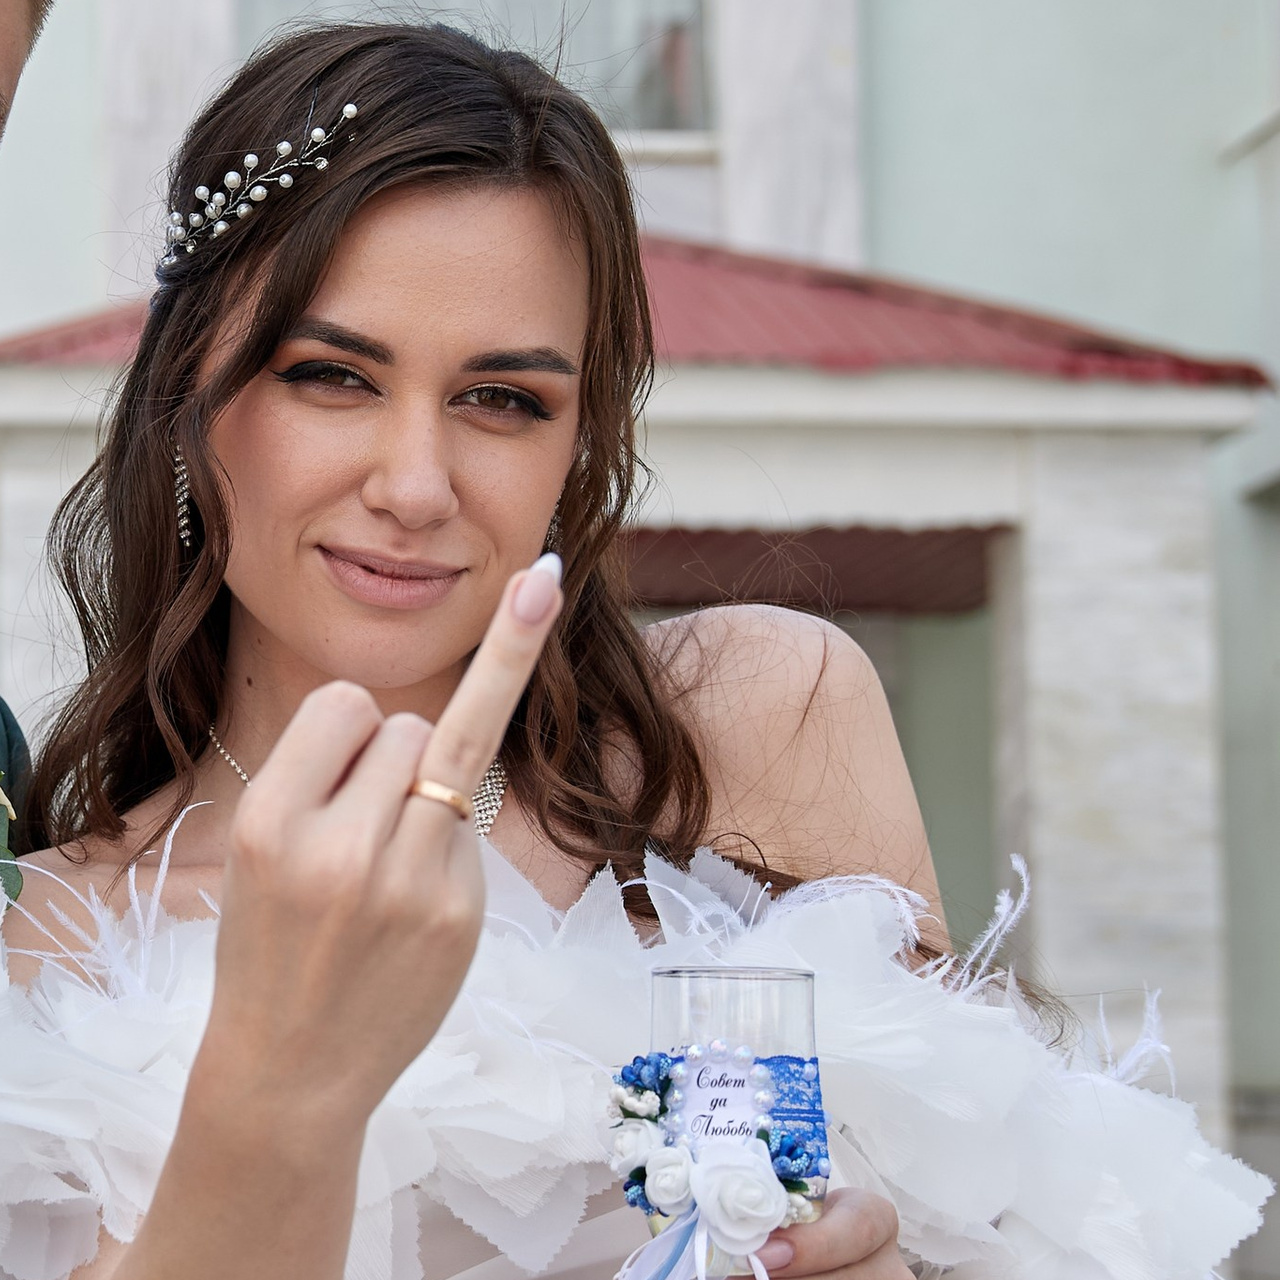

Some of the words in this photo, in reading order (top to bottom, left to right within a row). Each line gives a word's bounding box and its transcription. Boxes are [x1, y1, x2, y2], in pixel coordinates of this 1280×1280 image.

[696, 1065, 746, 1089] Совет
[709, 1097, 728, 1111] да
[690, 1114, 753, 1138] Любовь
